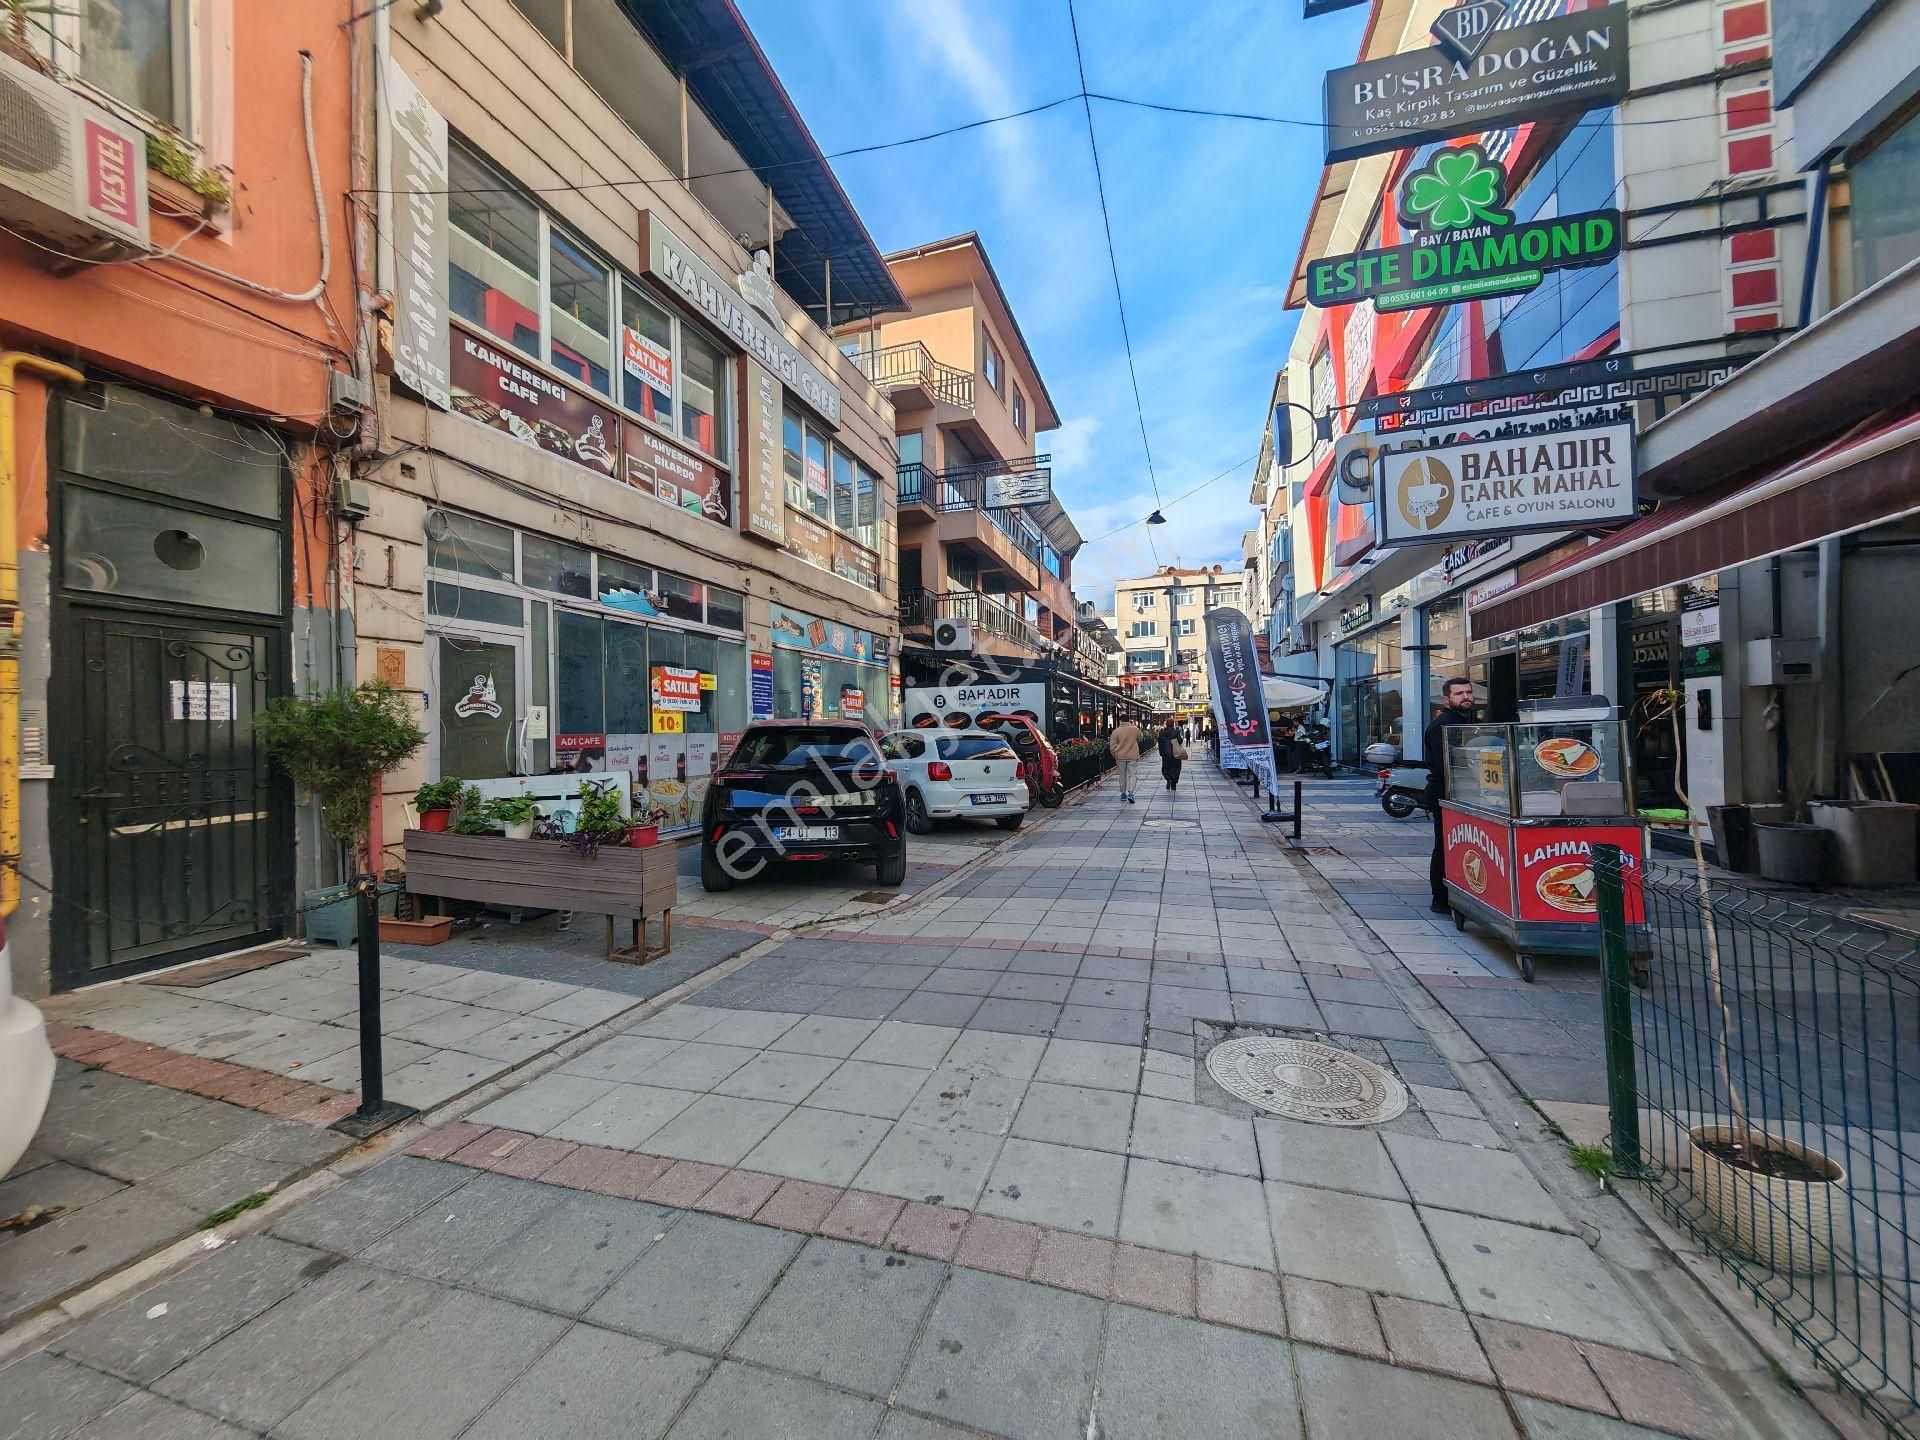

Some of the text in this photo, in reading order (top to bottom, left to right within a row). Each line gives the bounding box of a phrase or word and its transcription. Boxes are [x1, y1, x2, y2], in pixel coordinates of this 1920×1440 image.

[1457, 6, 1489, 40] BD
[1477, 25, 1612, 78] DOĞAN
[1365, 59, 1599, 121] Kaş Kirpik Tasarım ve Güzellik
[97, 134, 128, 216] VESTEL
[1420, 233, 1443, 248] BAY
[1452, 224, 1492, 243] BAYAN
[1315, 218, 1613, 297] ESTE DIAMOND
[661, 241, 838, 420] KAHVERENGİ CAFE
[399, 343, 446, 386] CAFE
[464, 338, 567, 402] KAHVERENGİ
[628, 342, 670, 381] SATILIK
[401, 370, 449, 408] KAT 2
[499, 376, 539, 406] CAFE
[643, 433, 704, 474] KAHVERENGİ
[654, 453, 696, 483] BİLARDO
[1460, 435, 1616, 483] BAHADIR
[1460, 467, 1621, 511] ÇARK MAHAL
[1503, 504, 1513, 516] &
[1517, 501, 1554, 515] OYUN
[1558, 496, 1617, 511] SALONU
[752, 513, 783, 536] RENGİ
[663, 679, 700, 695] SATILIK
[958, 687, 1021, 701] BAHADIR
[560, 736, 601, 747] ADI CAFE
[780, 827, 792, 838] 54
[823, 826, 838, 837] 113
[1447, 822, 1505, 878] LAHMACUN
[1523, 840, 1635, 869] LAHMAN
